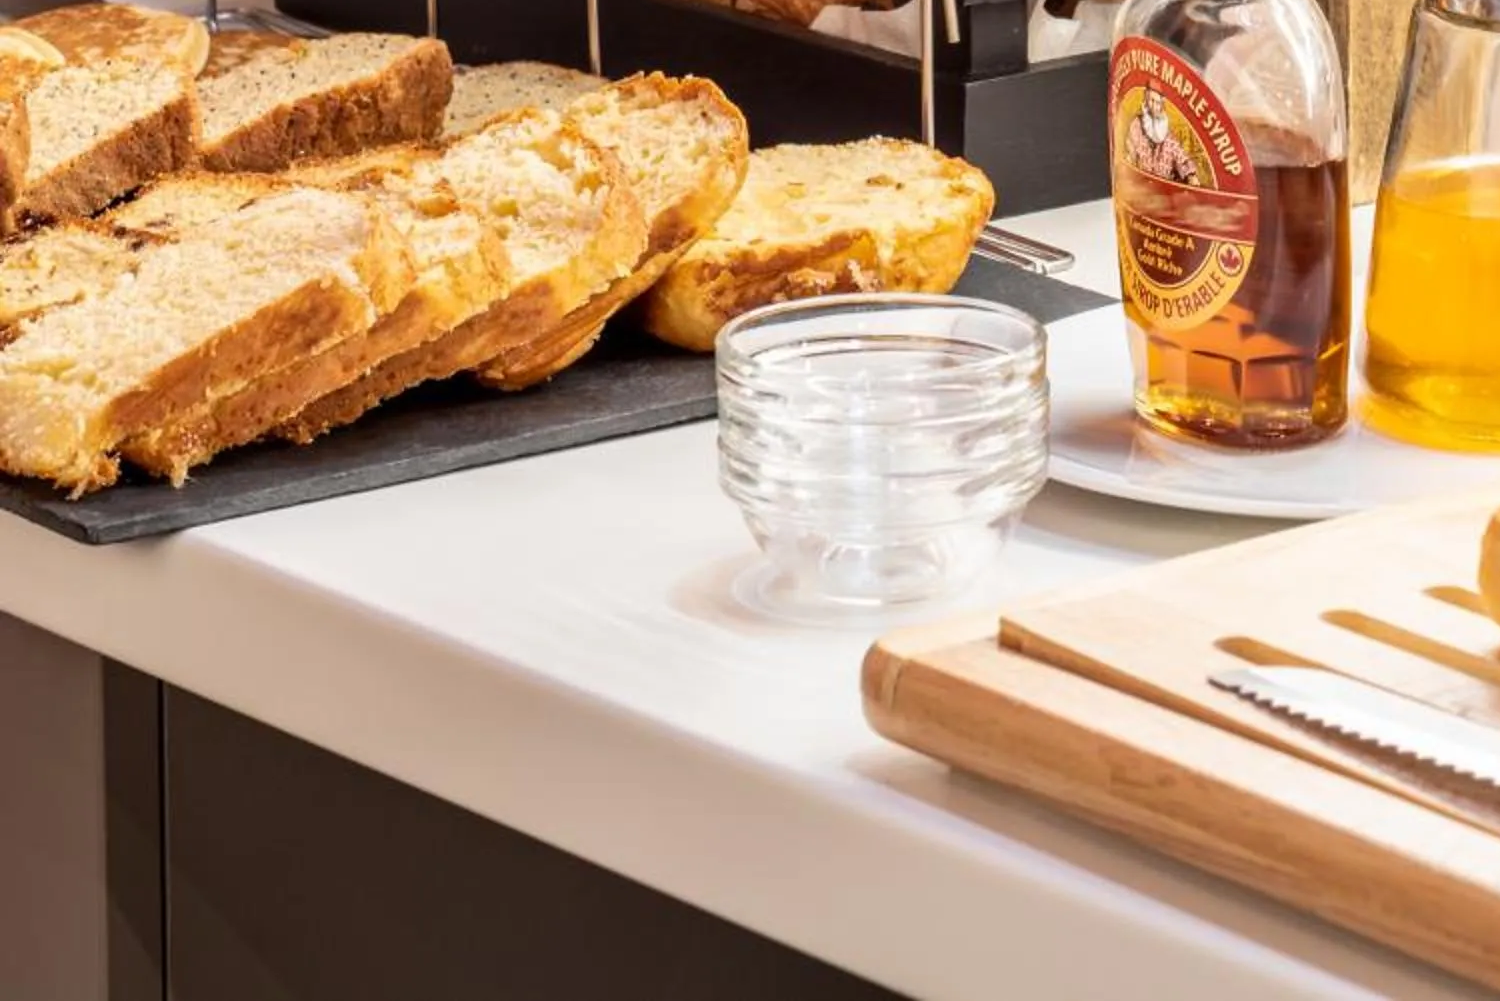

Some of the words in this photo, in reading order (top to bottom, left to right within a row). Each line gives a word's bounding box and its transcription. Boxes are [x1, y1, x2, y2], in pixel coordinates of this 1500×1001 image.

[1131, 50, 1161, 76] PURE
[1161, 60, 1209, 118] MAPLE
[1203, 111, 1243, 176] SYRUP
[1185, 237, 1195, 251] A
[1162, 270, 1226, 319] D'ERABLE
